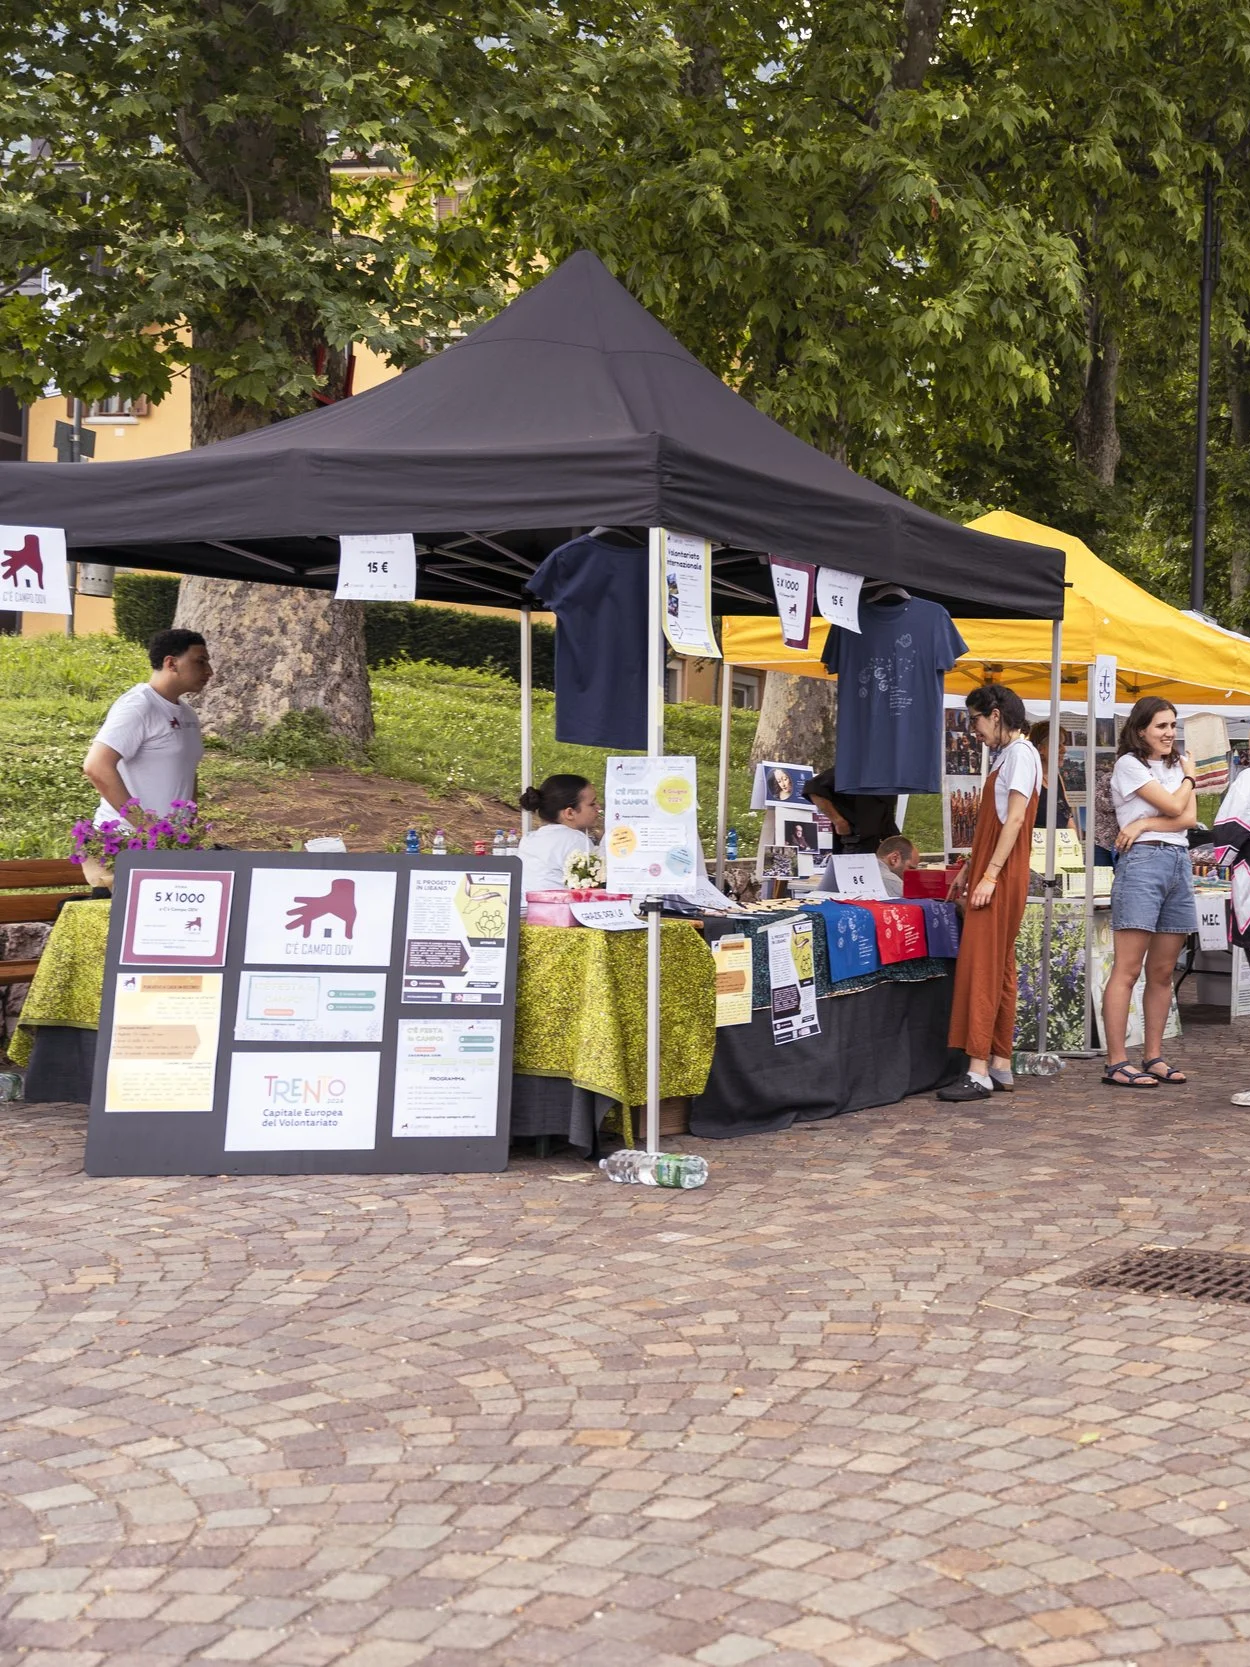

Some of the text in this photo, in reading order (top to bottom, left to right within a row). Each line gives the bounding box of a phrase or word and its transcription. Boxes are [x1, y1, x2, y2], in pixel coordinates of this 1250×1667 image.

[367, 561, 389, 573] 15 €
[785, 579, 800, 592] 1000
[832, 595, 838, 606] 15
[853, 876, 858, 885] 8
[155, 892, 205, 903] 5 X 1000
[285, 942, 353, 956] C'È CAMPO ODV
[264, 1075, 346, 1104] TRENTO
[262, 1108, 343, 1119] Capitale Europea
[279, 1118, 338, 1127] Volontariato
